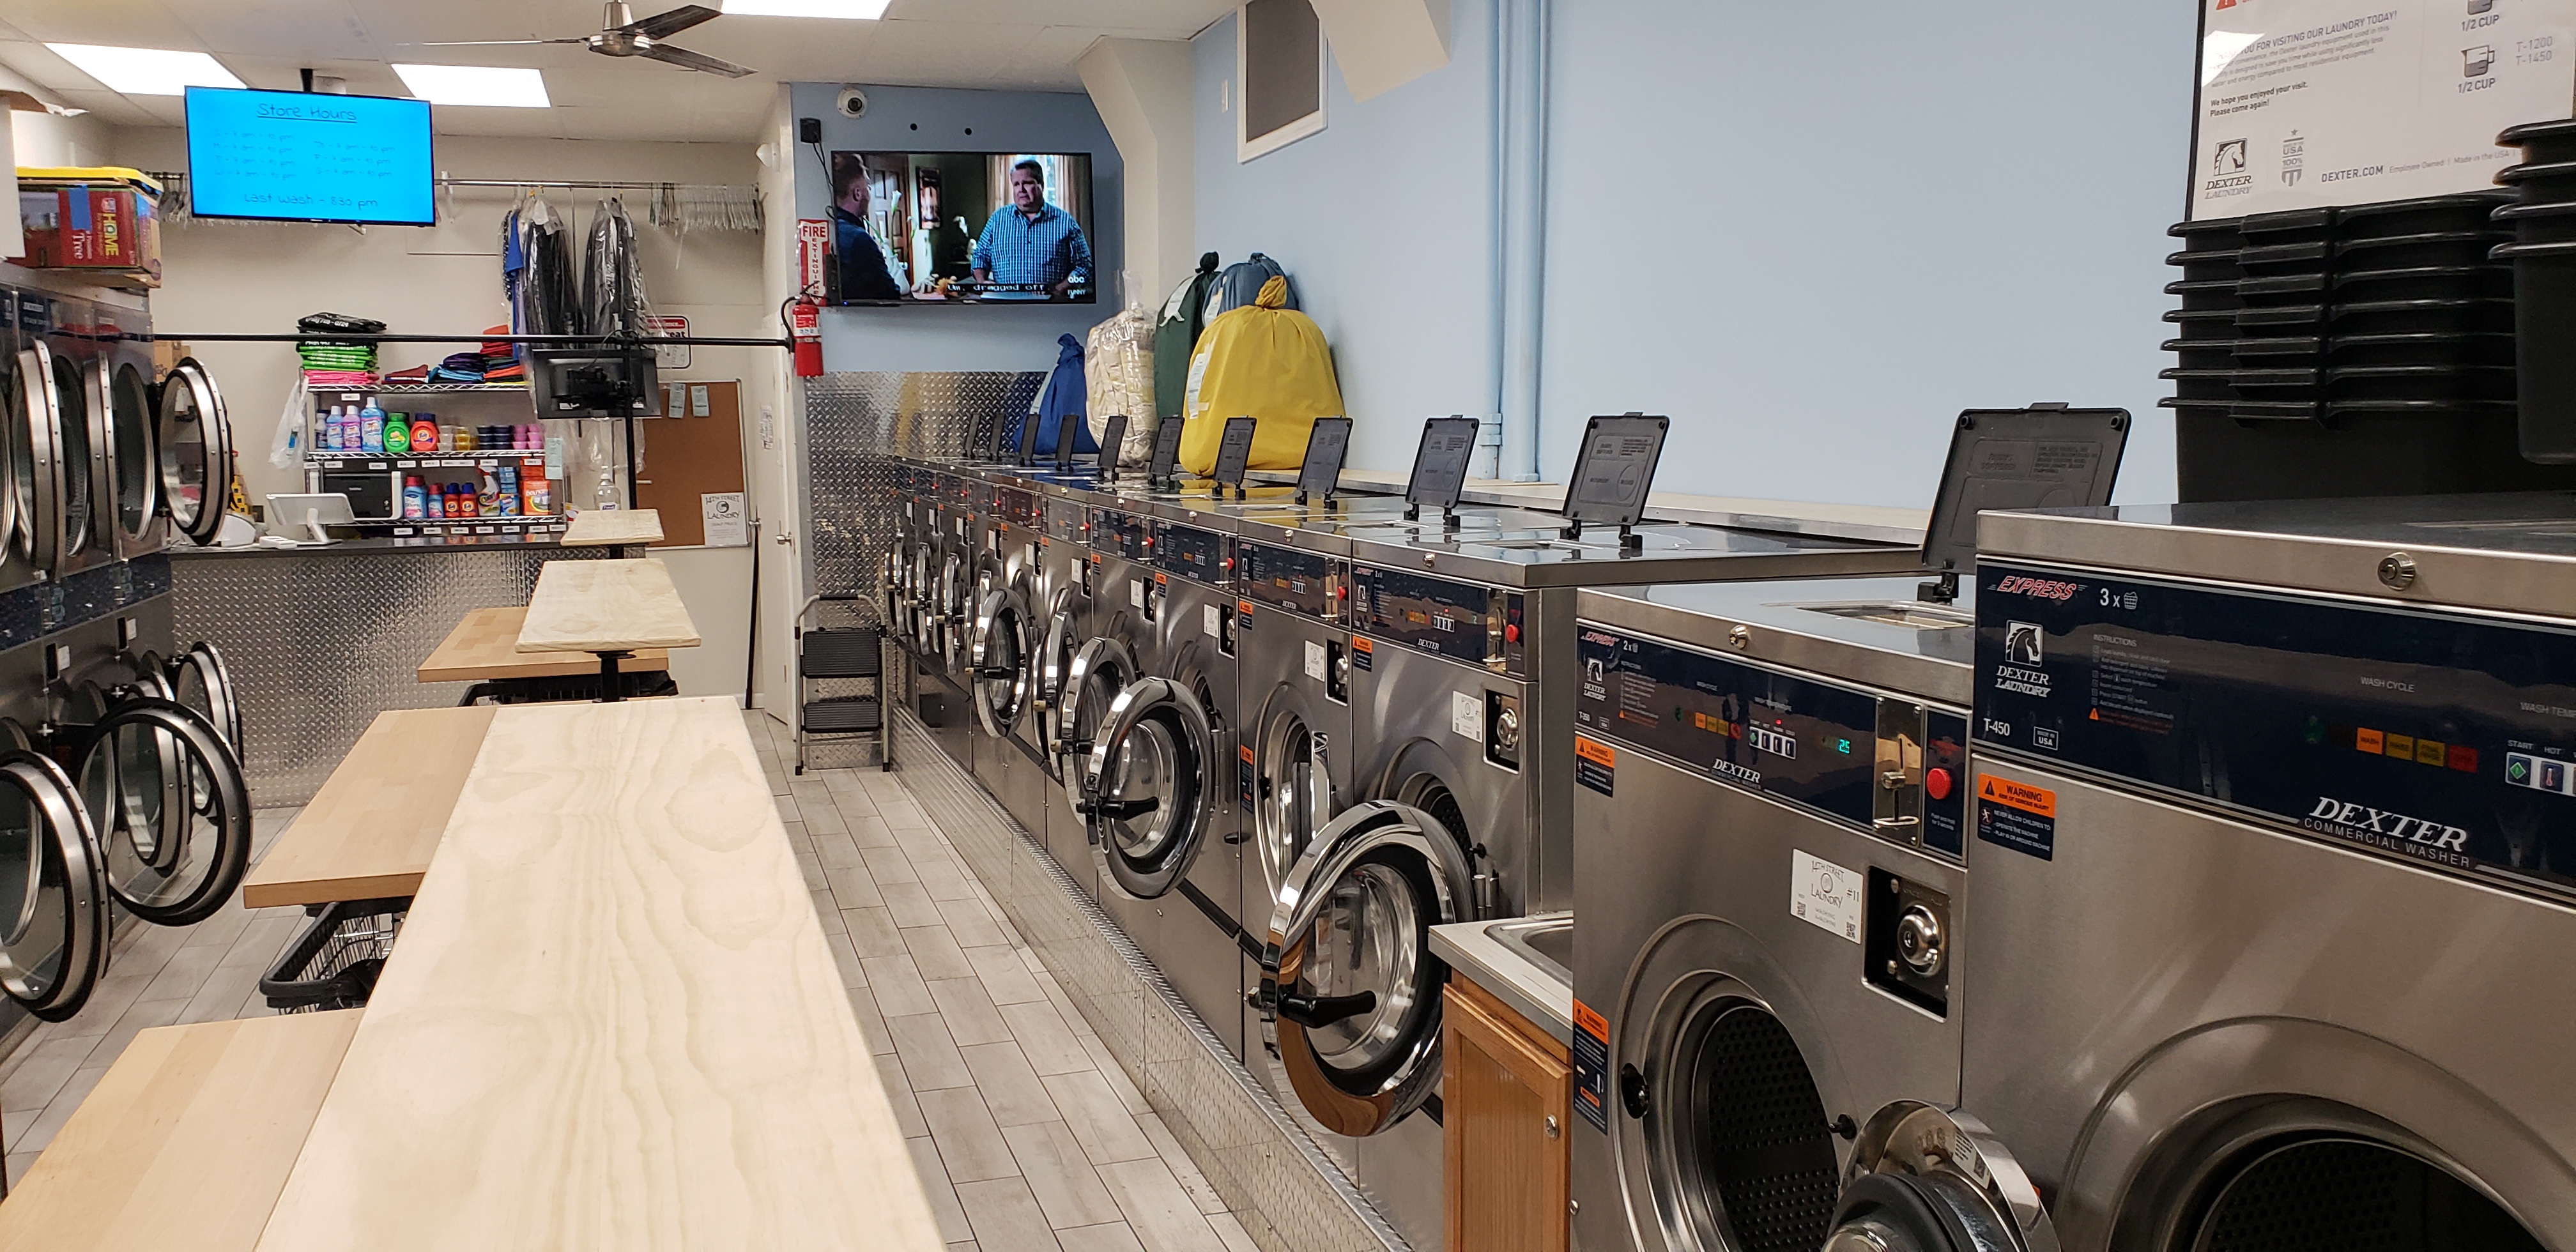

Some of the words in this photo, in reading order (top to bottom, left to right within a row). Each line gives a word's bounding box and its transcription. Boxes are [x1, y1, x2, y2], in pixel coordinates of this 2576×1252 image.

[2256, 40, 2271, 52] FOR
[2273, 32, 2305, 47] VISITING
[2306, 27, 2324, 39] OUR
[2326, 18, 2365, 34] LAUNDRY
[2367, 10, 2397, 25] TODAY!
[2461, 19, 2476, 32] 1/2
[2478, 14, 2499, 27] CUP
[2516, 36, 2553, 53] T-1200
[2515, 50, 2552, 66] T-1450
[2221, 96, 2236, 106] hope
[2237, 94, 2248, 103] you
[2250, 88, 2274, 100] enjoyed
[2275, 85, 2291, 95] your
[2292, 81, 2308, 91] visit.
[2458, 81, 2473, 94] 1/2
[2475, 77, 2496, 91] CUP
[256, 103, 302, 117] Store
[310, 105, 356, 121] Hours
[2210, 107, 2230, 118] Please
[2232, 103, 2248, 113] come
[2250, 99, 2270, 111] again!
[2282, 145, 2304, 155] USA
[2282, 158, 2303, 167] 100%
[2321, 165, 2384, 183] DEXTER.COM
[2389, 162, 2420, 173] Employee
[2421, 158, 2445, 169] Owned
[2454, 155, 2472, 164] Made
[2481, 152, 2493, 161] the
[2494, 149, 2510, 159] USA
[2205, 175, 2251, 190] DEXTER
[2204, 185, 2253, 199] LAUNDRY
[244, 193, 273, 203] Last
[358, 199, 378, 211] pm
[104, 213, 119, 256] HOME
[802, 225, 826, 238] FIRE
[72, 233, 84, 260] Tree
[1068, 275, 1085, 283] abc
[973, 284, 1019, 293] dragged
[1997, 575, 2077, 601] EXPRESS
[2099, 588, 2110, 606] 3
[1418, 637, 1440, 650] DEXTER
[1623, 639, 1629, 651] 2
[2093, 634, 2138, 647] INSTRUCTIONS
[1996, 665, 2050, 685] DEXTER
[1583, 682, 1606, 694] DEXTER
[1994, 678, 2051, 698] LAUNDRY
[2361, 676, 2385, 688] WASH
[2386, 680, 2415, 693] CYCLE
[2520, 702, 2550, 714] WASH
[1982, 717, 2011, 737] T-450
[1838, 738, 1850, 754] 25
[2038, 736, 2053, 747] USA
[2508, 739, 2534, 751] START
[2544, 746, 2562, 755] HOT
[1713, 758, 1761, 784] DEXTER
[2006, 784, 2043, 802] WARNING
[2023, 818, 2044, 829] CHILDREN
[2309, 797, 2467, 852] DEXTER
[2304, 818, 2398, 850] COMMERCIAL
[2405, 843, 2469, 868] WASHER
[1811, 860, 1825, 873] 14TH
[1826, 864, 1844, 883] STREET
[1811, 883, 1843, 909] LAUNDRY
[1846, 887, 1859, 902] #11
